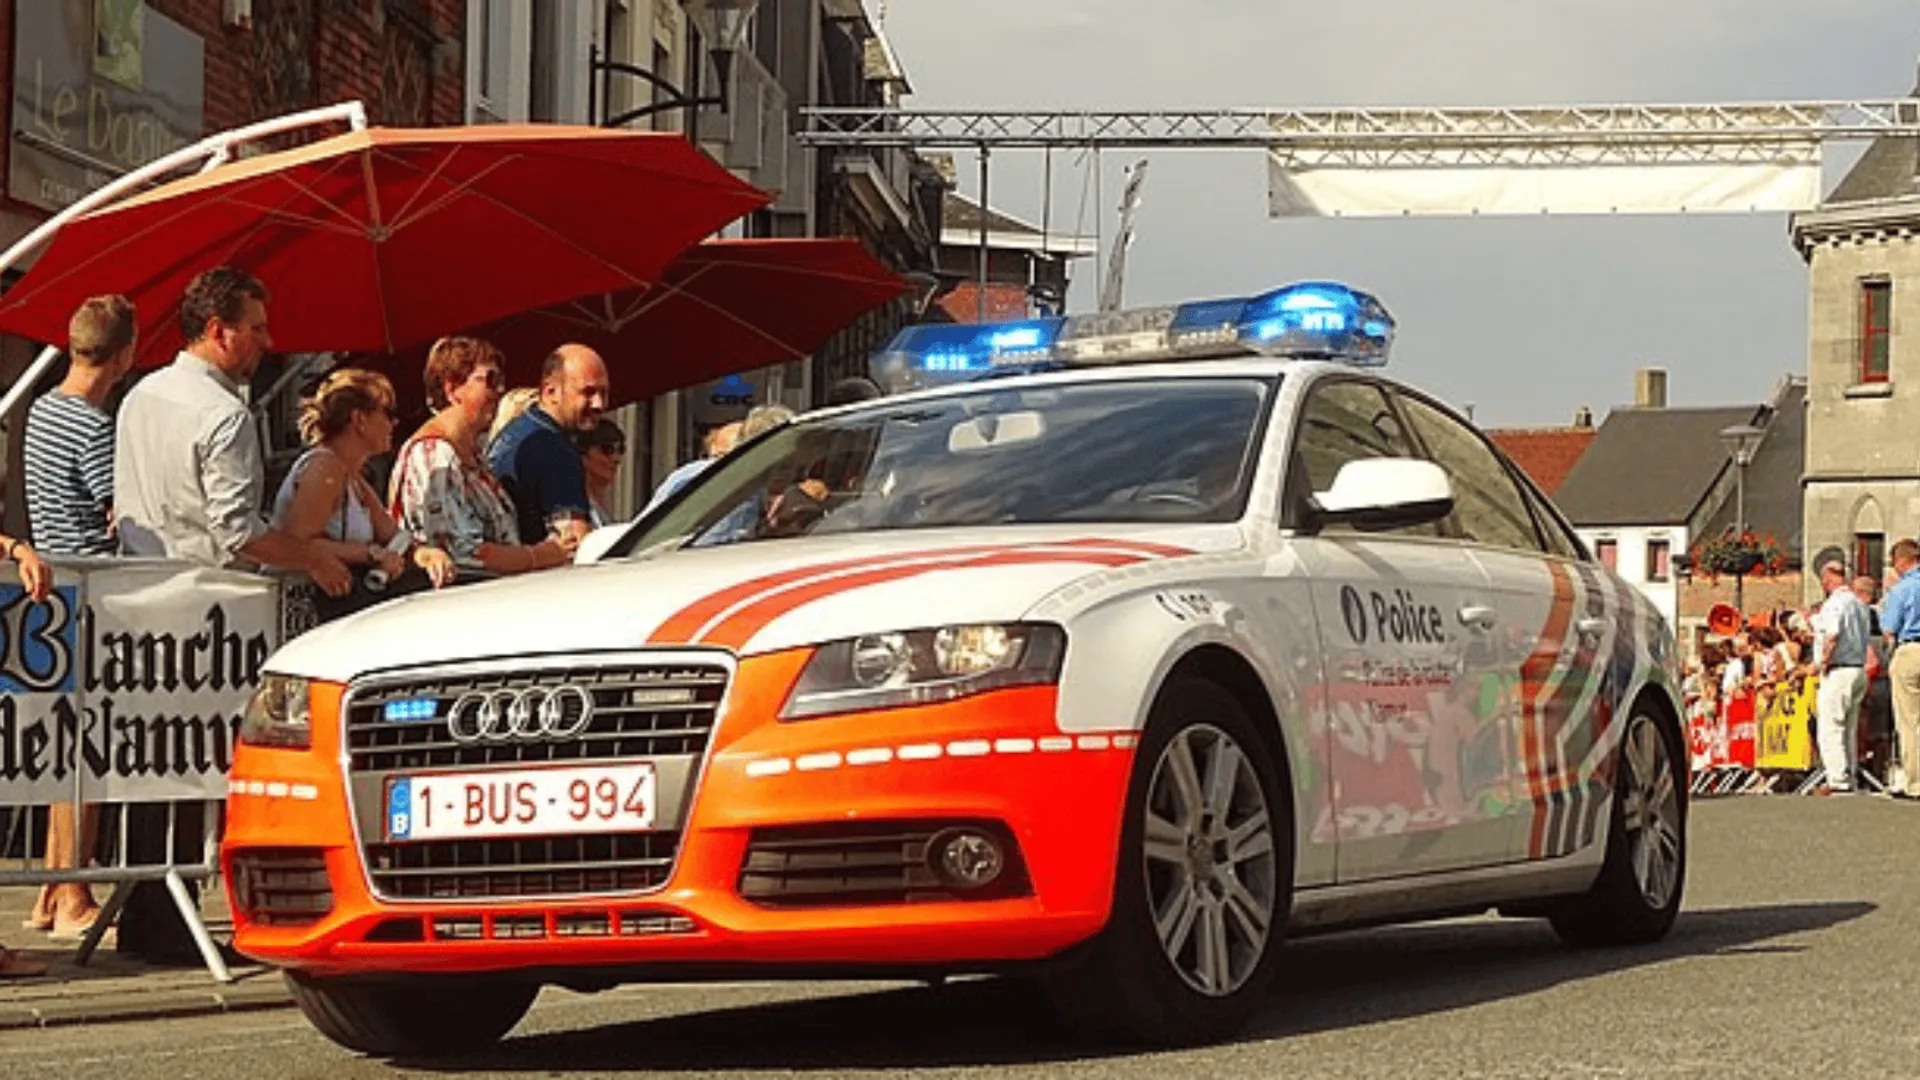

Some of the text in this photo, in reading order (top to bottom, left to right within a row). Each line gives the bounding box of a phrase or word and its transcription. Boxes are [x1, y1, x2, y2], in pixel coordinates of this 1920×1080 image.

[0, 591, 268, 693] Blanche
[1370, 589, 1446, 645] Police
[393, 814, 407, 834] B
